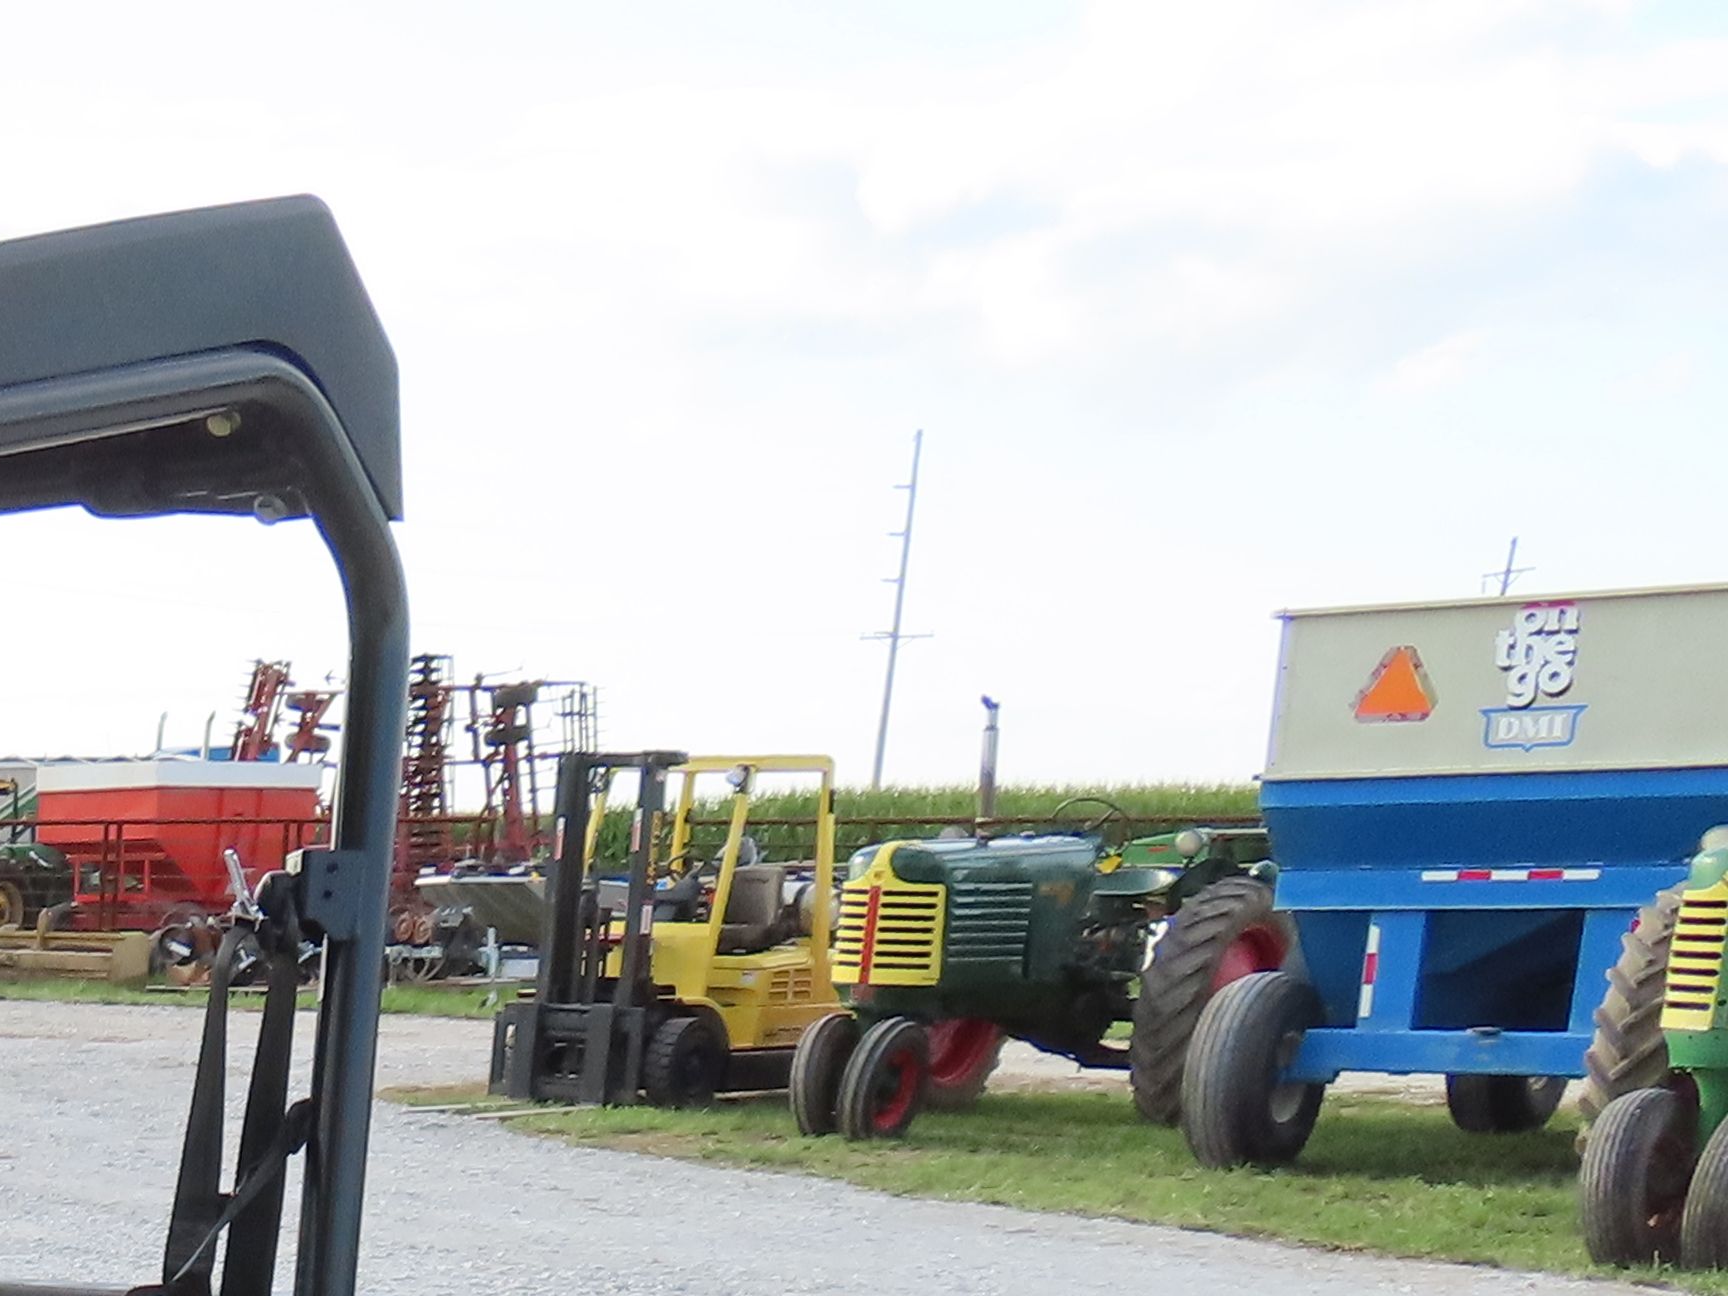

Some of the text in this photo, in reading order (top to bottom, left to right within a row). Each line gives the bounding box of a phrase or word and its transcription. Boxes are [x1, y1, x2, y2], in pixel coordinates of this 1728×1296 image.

[1515, 607, 1580, 635] on
[1496, 629, 1577, 671] the
[1506, 664, 1573, 710] go
[1496, 714, 1567, 741] DMI
